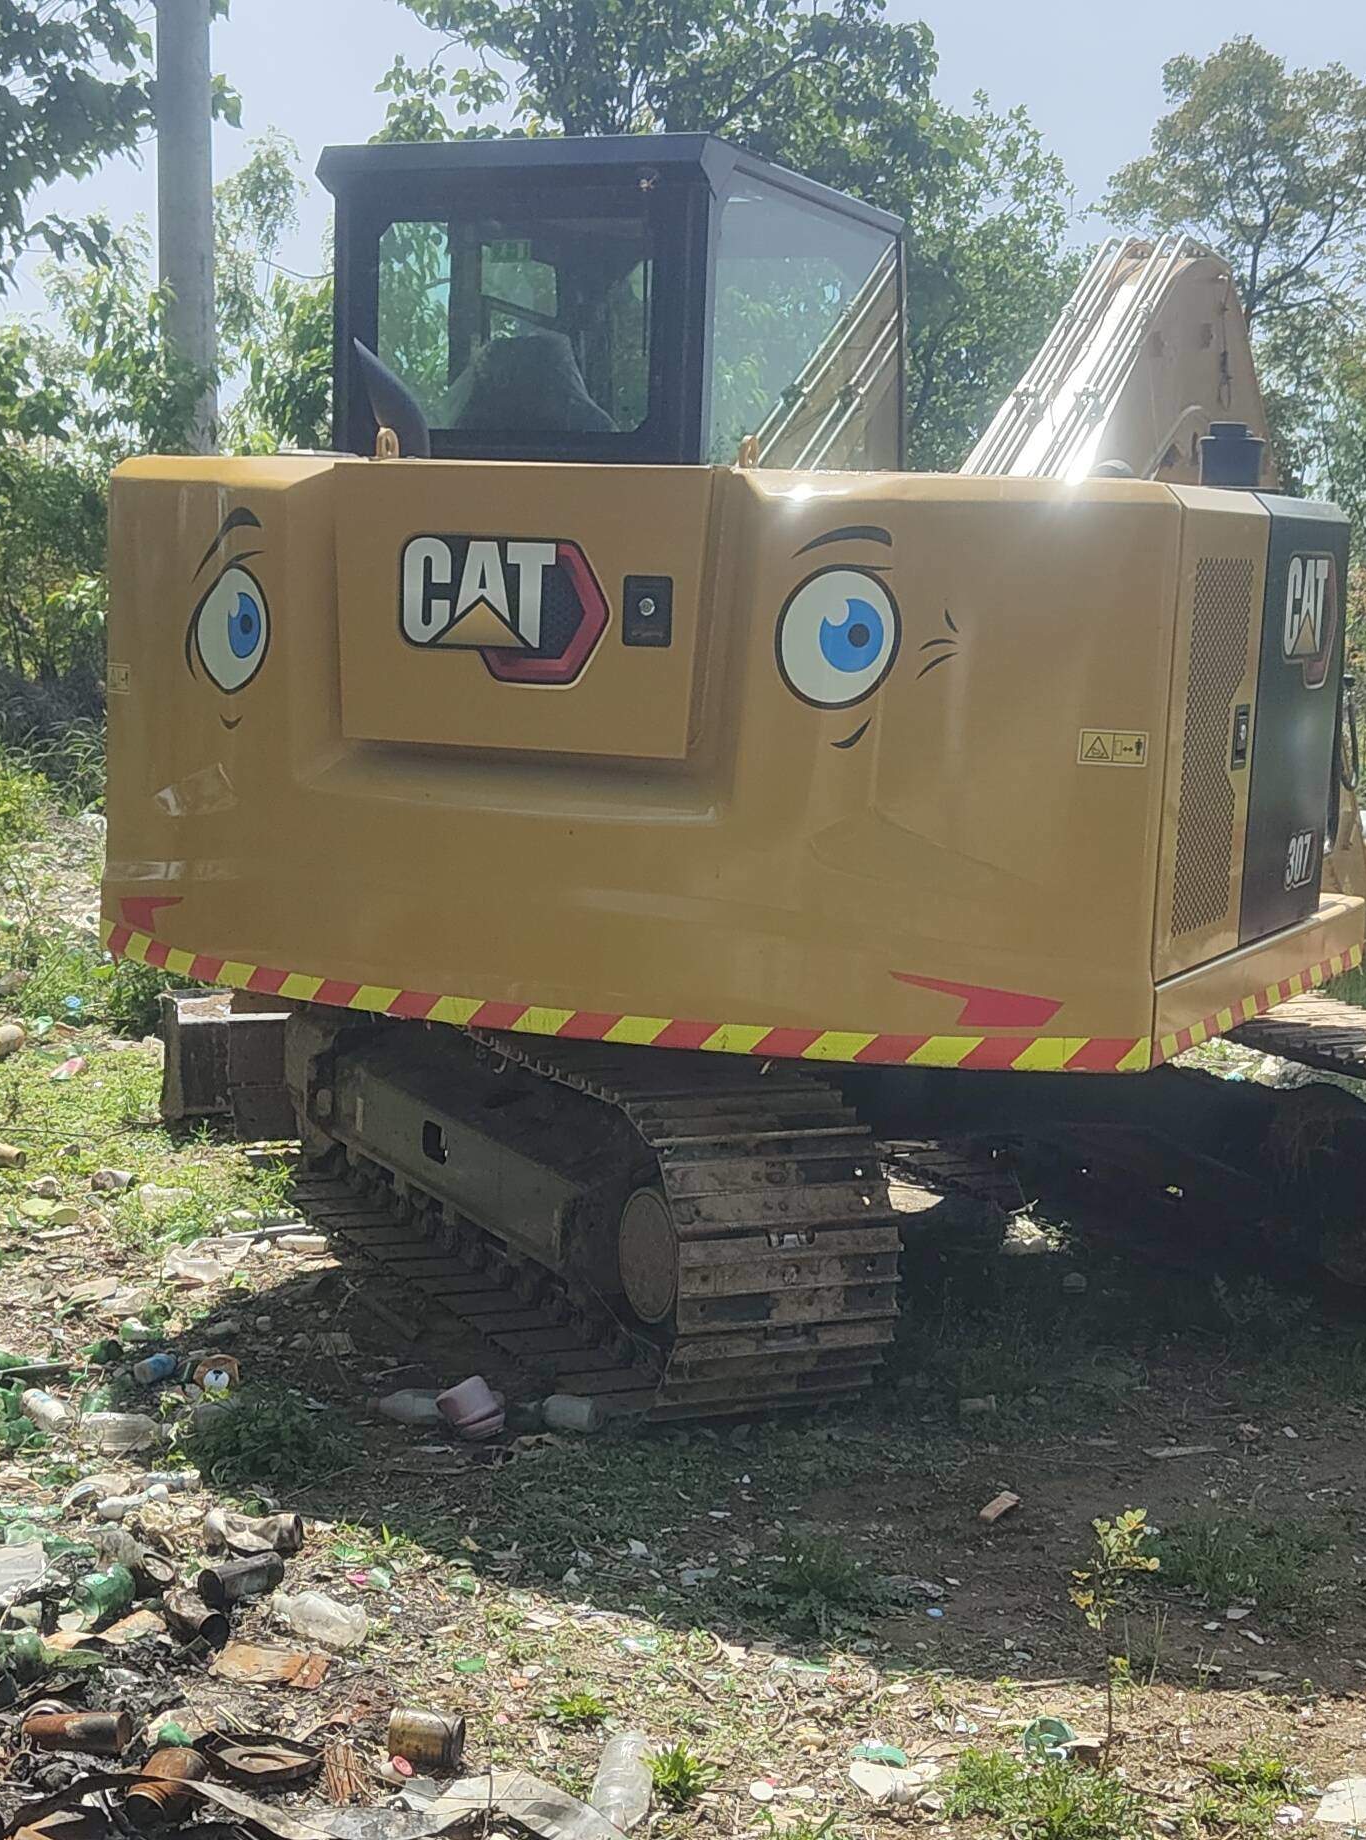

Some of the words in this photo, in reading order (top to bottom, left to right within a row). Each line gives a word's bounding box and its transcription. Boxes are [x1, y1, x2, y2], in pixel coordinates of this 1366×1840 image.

[402, 536, 557, 649] CAT
[1283, 556, 1329, 656] CAT
[1285, 833, 1312, 885] 307
